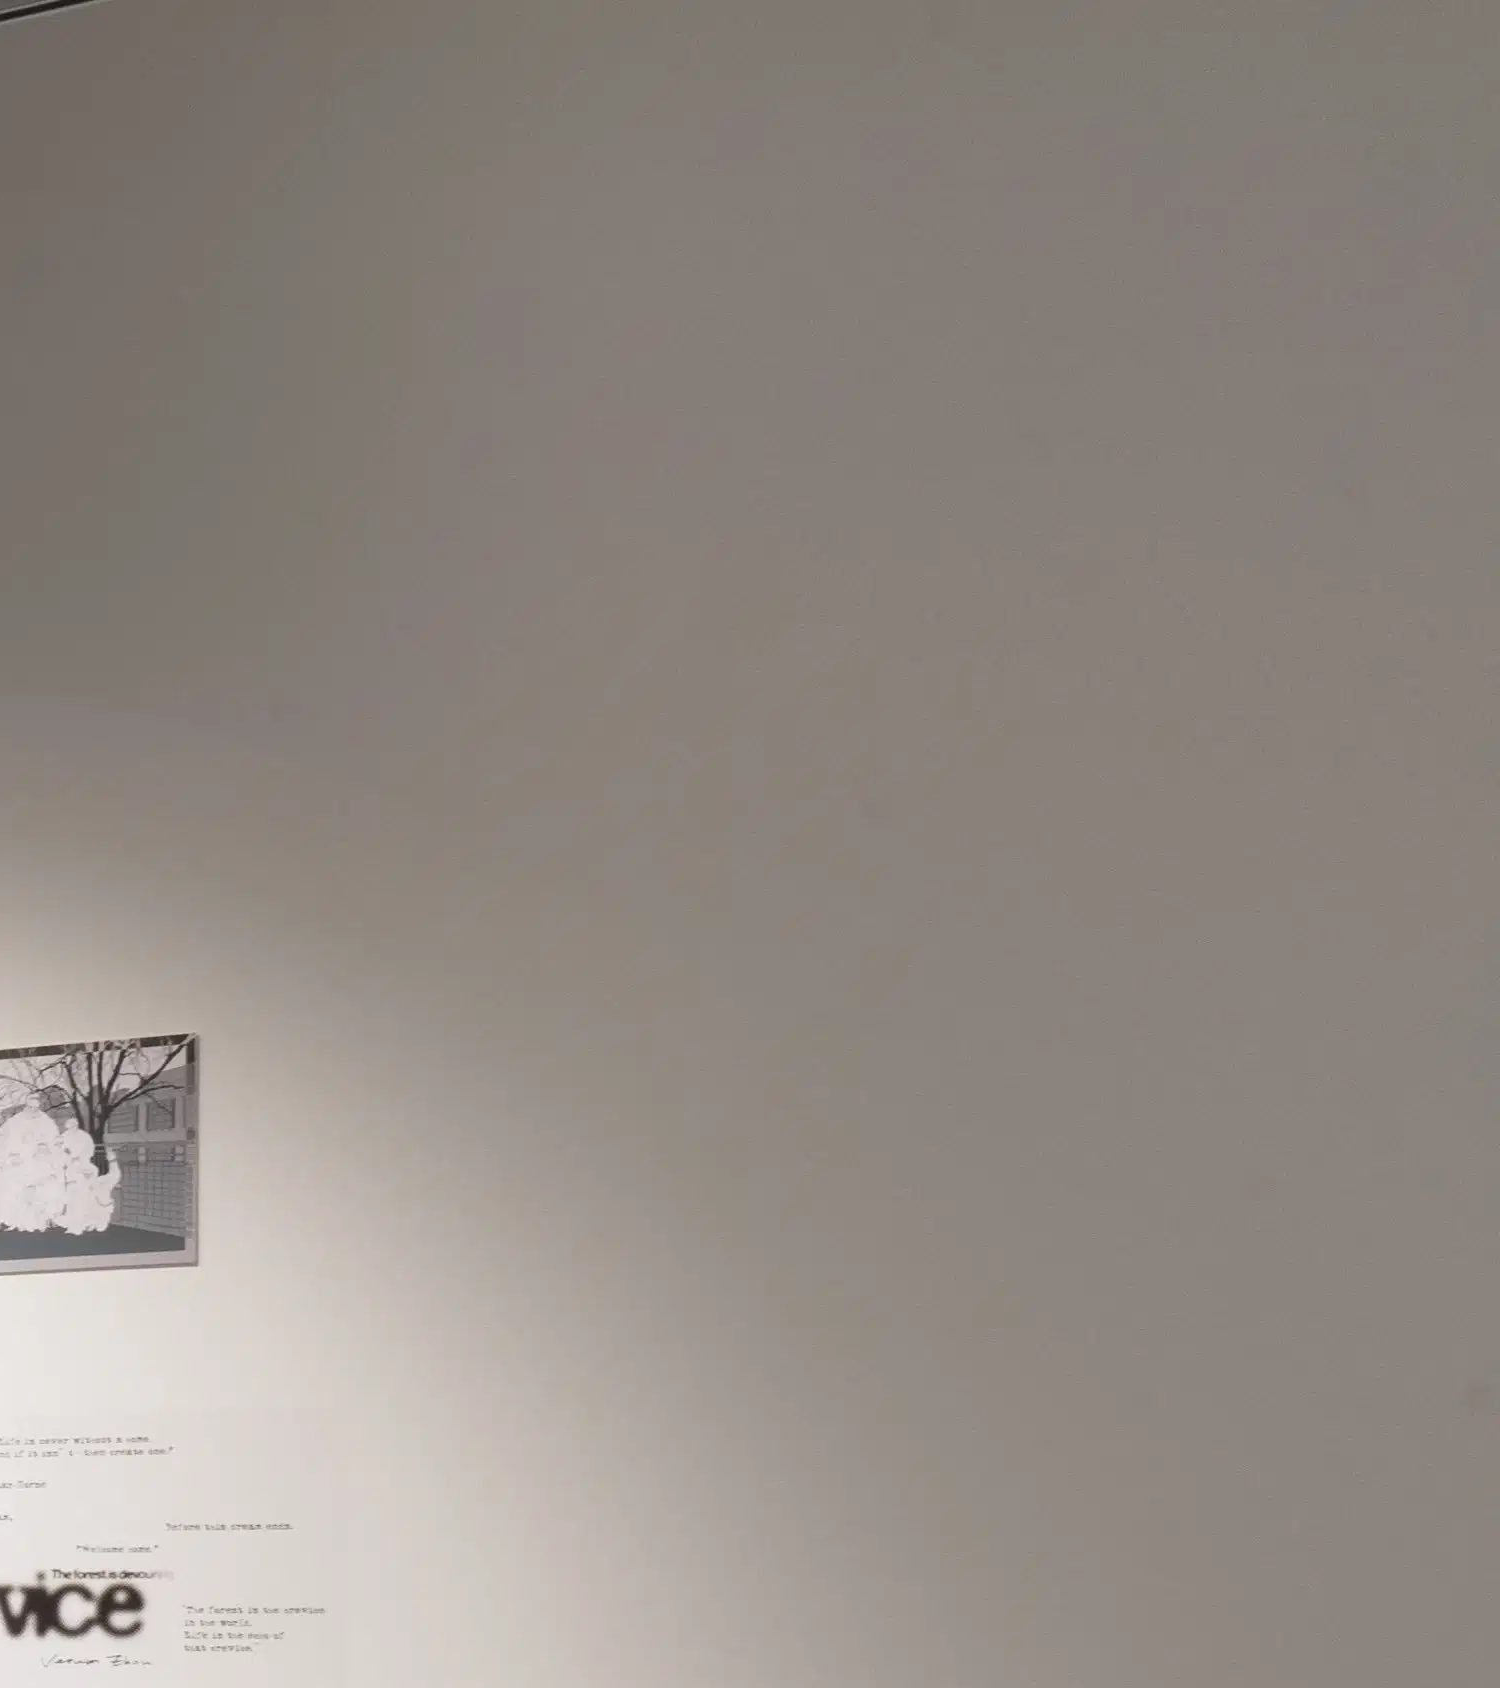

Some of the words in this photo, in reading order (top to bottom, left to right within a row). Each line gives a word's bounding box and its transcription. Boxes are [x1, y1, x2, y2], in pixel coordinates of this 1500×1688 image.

[51, 1568, 73, 1580] The
[73, 1568, 107, 1580] forest
[108, 1569, 117, 1580] is
